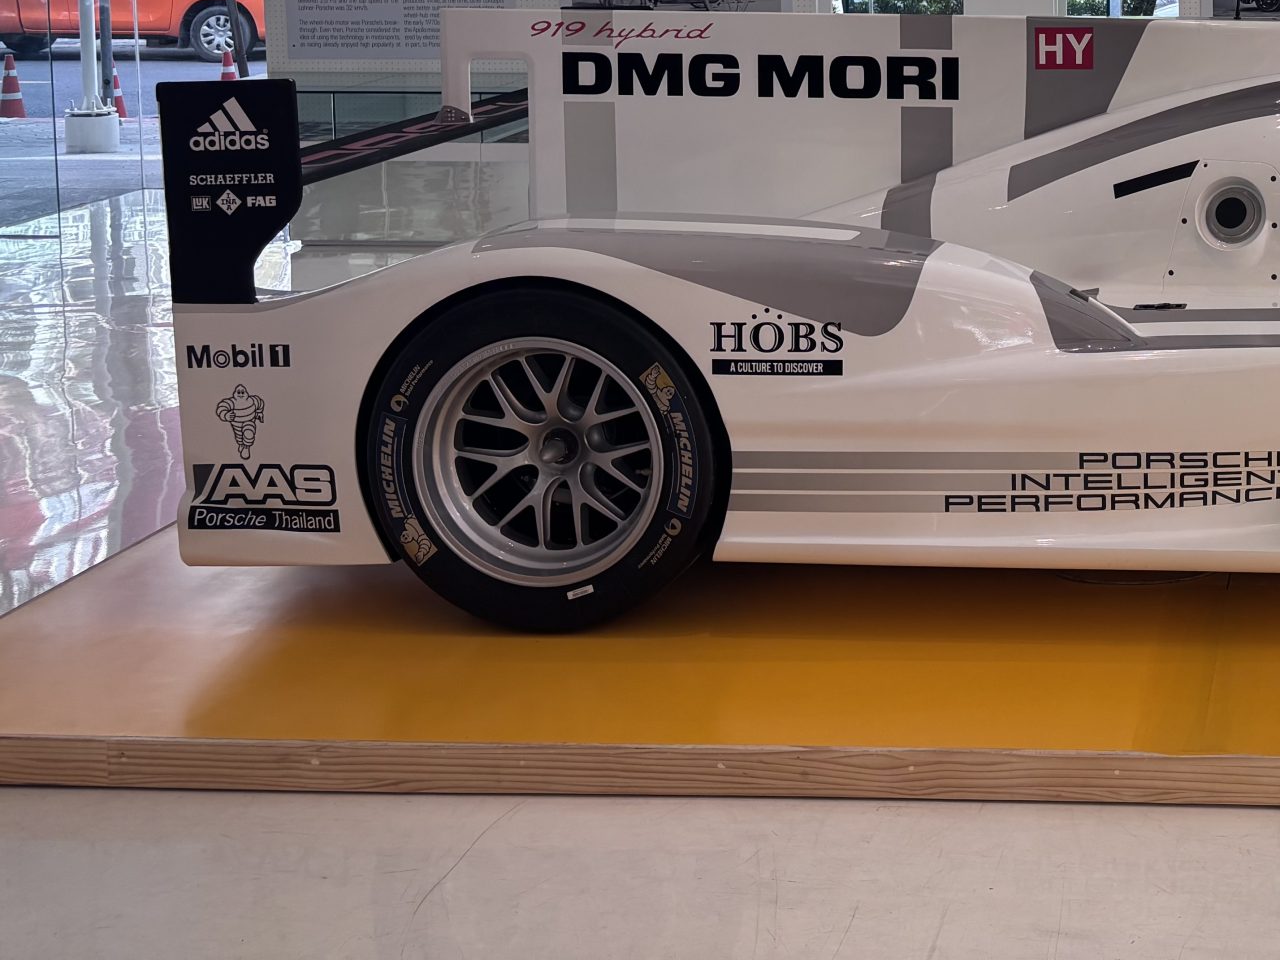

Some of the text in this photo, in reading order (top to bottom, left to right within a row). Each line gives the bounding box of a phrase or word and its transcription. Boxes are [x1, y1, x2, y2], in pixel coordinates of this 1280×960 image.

[530, 20, 714, 48] 919 hybrid
[1038, 33, 1092, 65] HY
[562, 52, 959, 100] DMG MORI
[189, 130, 270, 151] adidas
[189, 174, 275, 185] SCHAEFFLER
[247, 196, 276, 207] FAG
[186, 344, 264, 368] Mobil
[730, 362, 823, 373] A CULTURE TO DISCOVER
[400, 364, 420, 393] MICHELIN
[381, 418, 404, 518] MICHELIN
[670, 412, 693, 513] MICHELIN
[203, 464, 336, 506] AAS
[194, 508, 334, 529] Porsche Thailand
